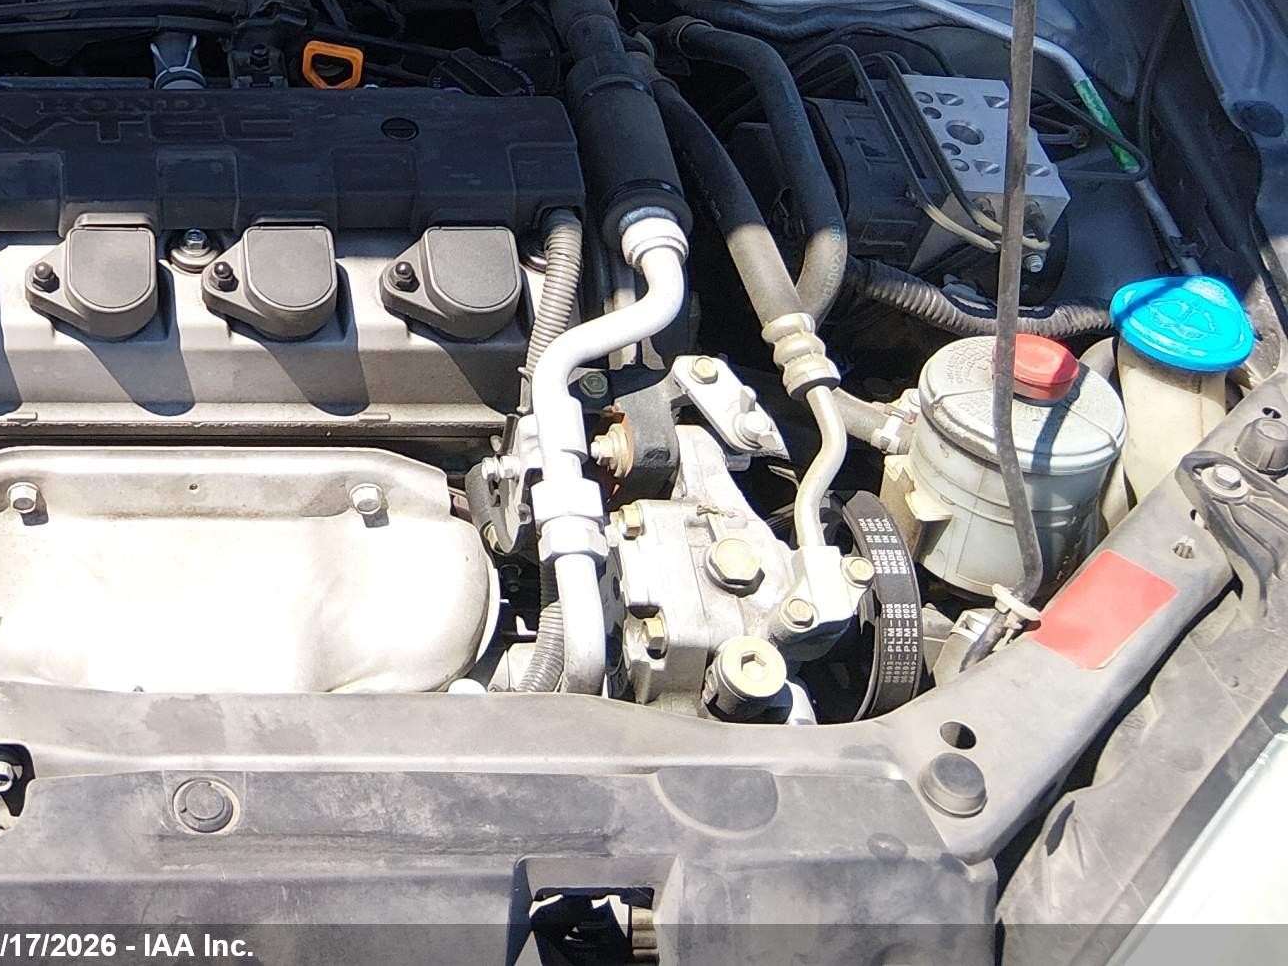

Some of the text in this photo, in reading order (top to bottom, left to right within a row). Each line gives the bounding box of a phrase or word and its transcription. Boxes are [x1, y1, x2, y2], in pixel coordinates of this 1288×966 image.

[882, 518, 893, 532] USA
[889, 535, 898, 543] IN
[858, 518, 883, 574] MADE IN USA
[866, 518, 891, 574] MADE IN USA
[874, 518, 899, 574] MADE IN USA
[894, 549, 907, 574] MADE
